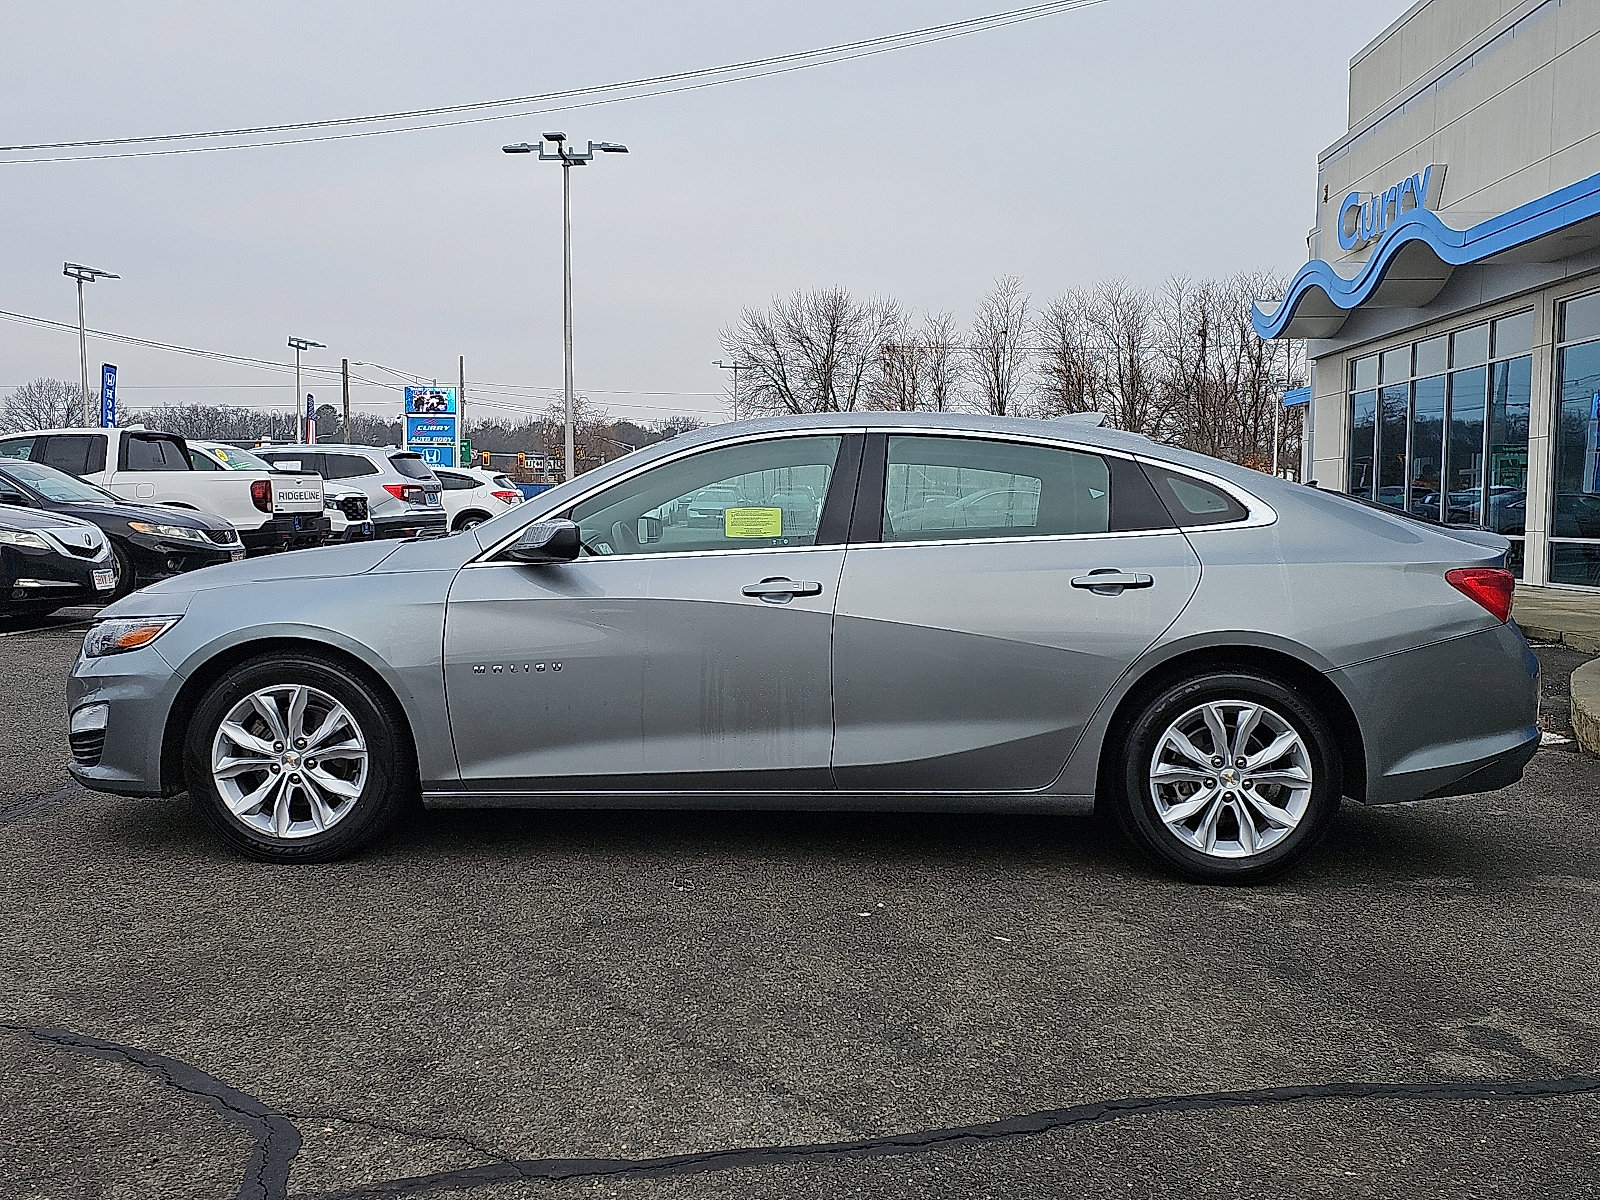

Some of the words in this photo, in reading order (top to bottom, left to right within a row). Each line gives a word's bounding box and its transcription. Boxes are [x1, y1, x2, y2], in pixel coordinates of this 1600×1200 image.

[1338, 165, 1436, 250] Curry
[278, 491, 320, 501] RIDGELINE
[472, 662, 563, 674] MALIBU
